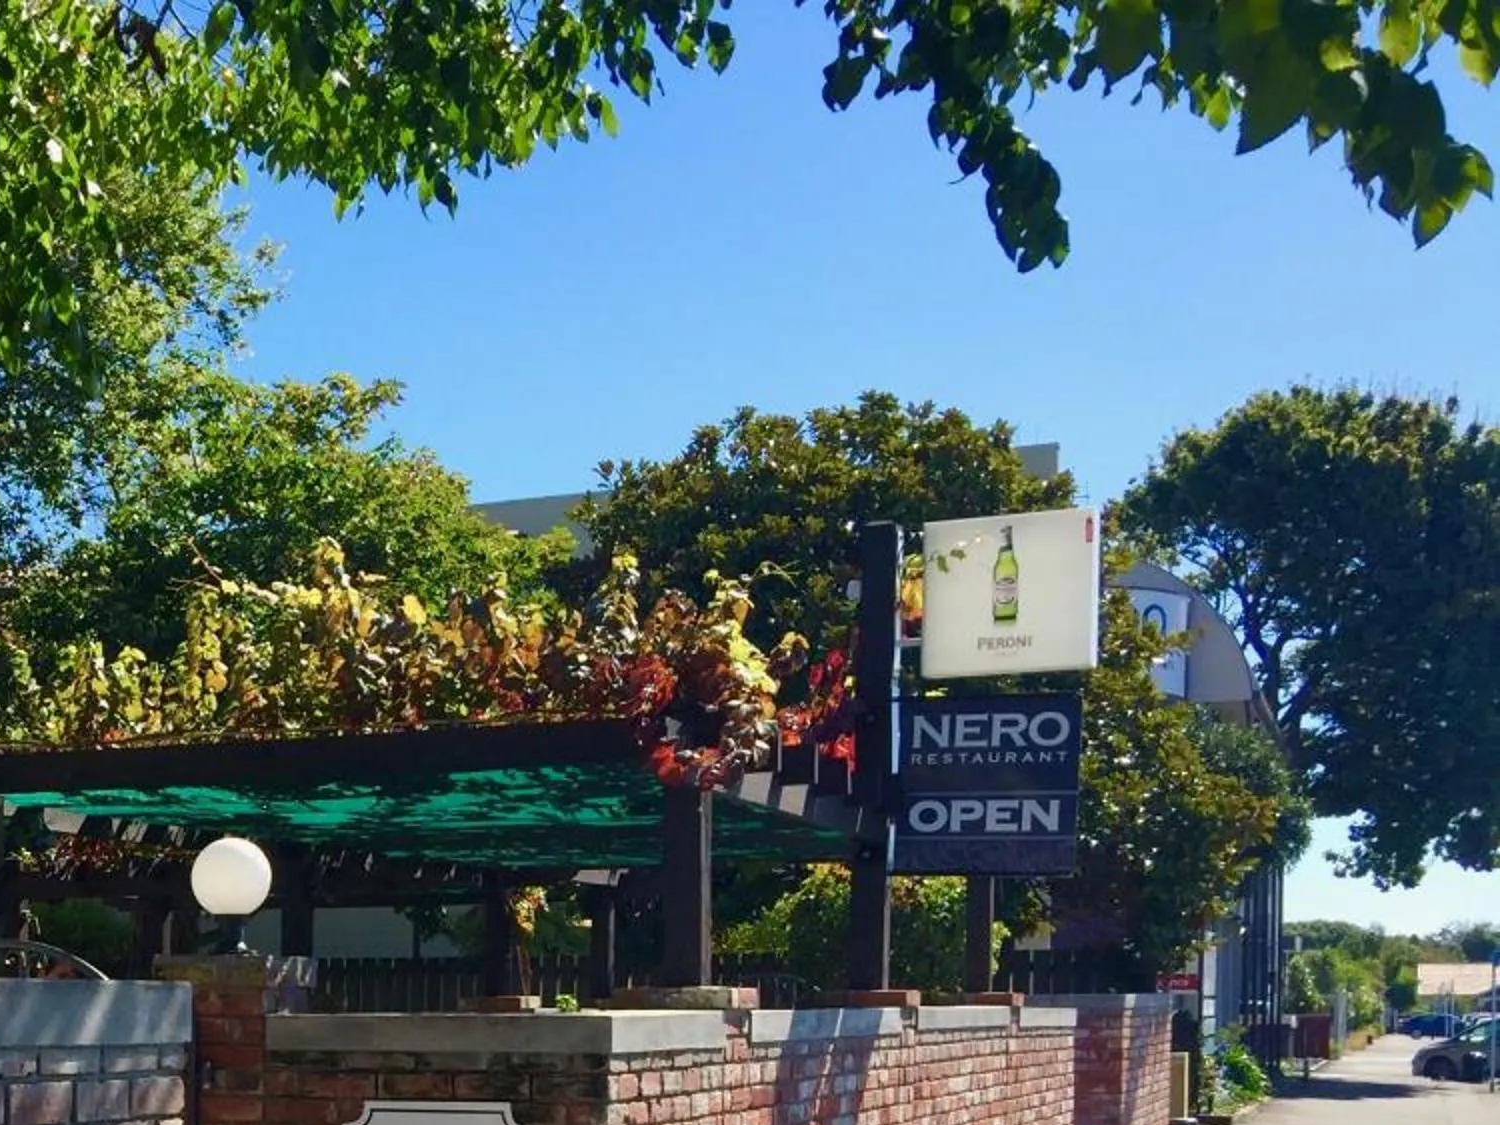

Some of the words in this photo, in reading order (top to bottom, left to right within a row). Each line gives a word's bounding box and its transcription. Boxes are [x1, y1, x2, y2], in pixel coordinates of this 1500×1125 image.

[977, 636, 1033, 650] PERONI
[912, 711, 1070, 748] NERO
[911, 751, 1069, 765] RESTAURANT
[908, 799, 1061, 833] OPEN
